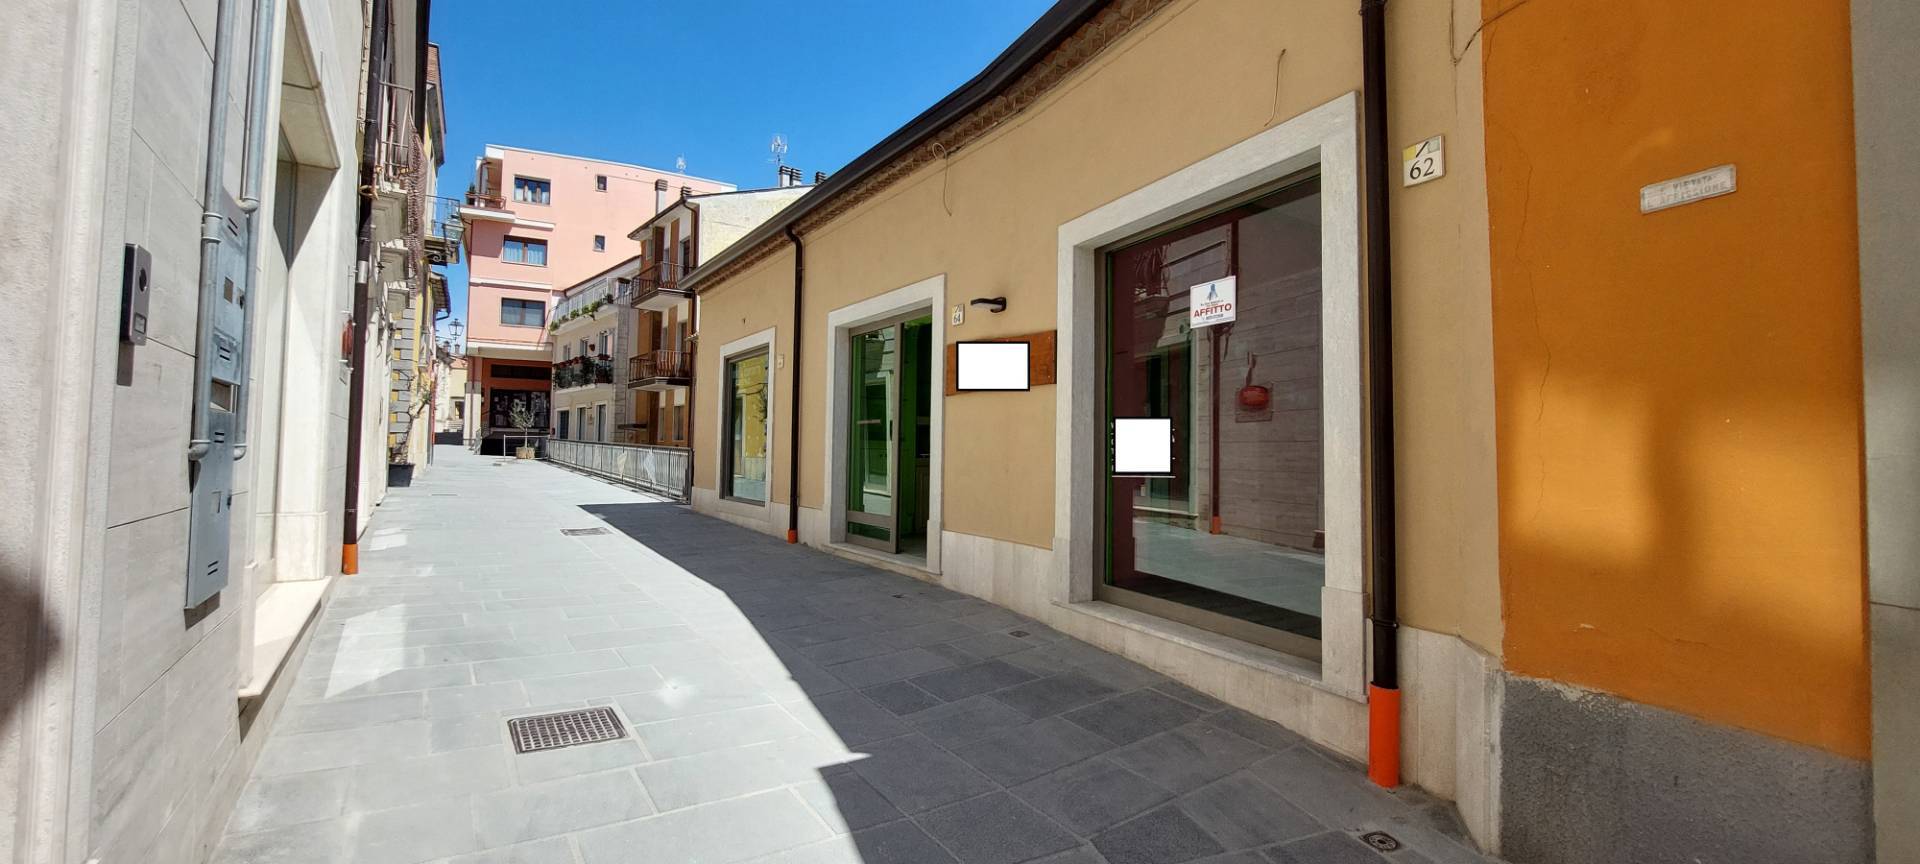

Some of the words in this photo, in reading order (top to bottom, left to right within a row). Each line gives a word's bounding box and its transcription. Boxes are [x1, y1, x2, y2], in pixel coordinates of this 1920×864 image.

[1409, 157, 1435, 180] 62
[953, 313, 961, 323] 64
[1193, 302, 1232, 318] AFFITTO
